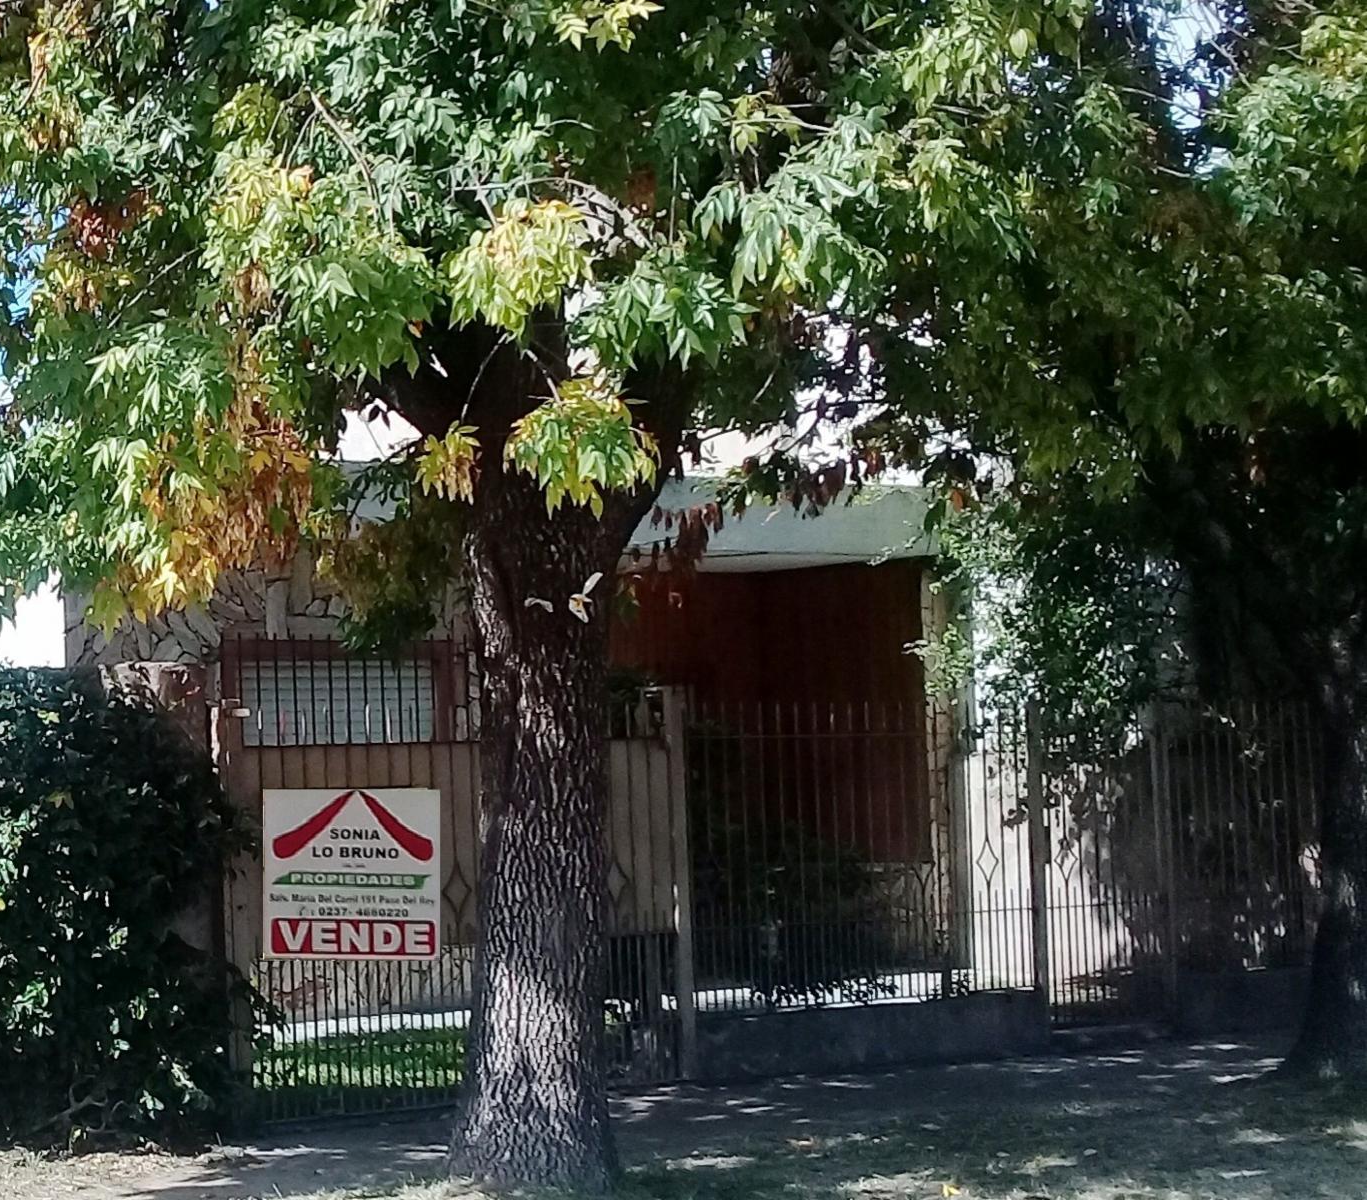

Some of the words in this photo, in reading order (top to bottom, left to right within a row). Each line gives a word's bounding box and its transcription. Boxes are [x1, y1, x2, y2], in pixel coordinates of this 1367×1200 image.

[330, 828, 381, 841] SONIA
[312, 846, 333, 858] LO
[339, 847, 400, 860] BRUNO
[290, 873, 415, 886] PROPIEDADES
[318, 894, 332, 903] Del
[402, 895, 417, 905] Del
[277, 920, 432, 954] VENDE
